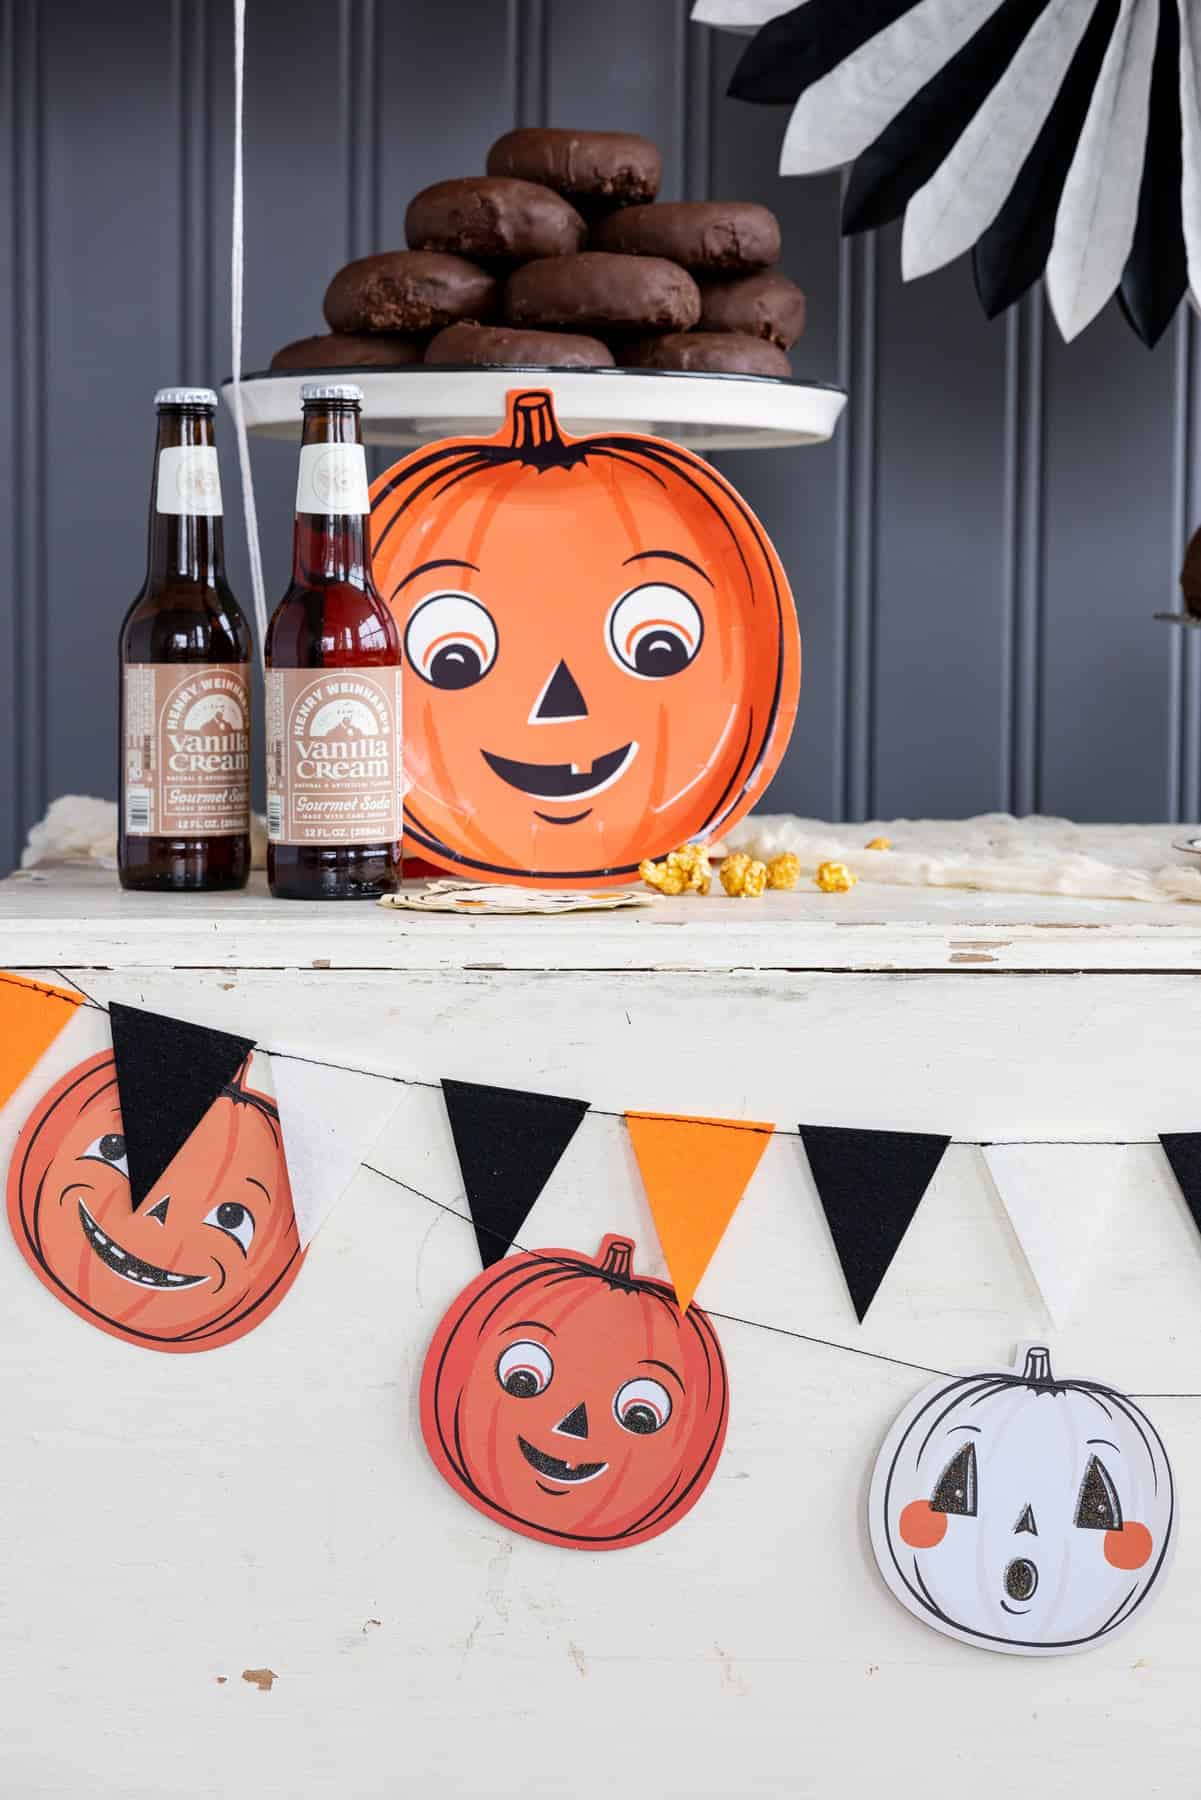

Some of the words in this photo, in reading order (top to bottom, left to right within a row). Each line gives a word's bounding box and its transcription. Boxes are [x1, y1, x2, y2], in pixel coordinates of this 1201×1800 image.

[167, 682, 198, 730] HENRY
[294, 686, 323, 736] HENRY
[295, 739, 388, 760] Vanilla
[167, 788, 228, 805] Gourmet
[295, 796, 358, 813] Gourmet
[360, 795, 391, 811] Soda
[304, 827, 316, 838] 12
